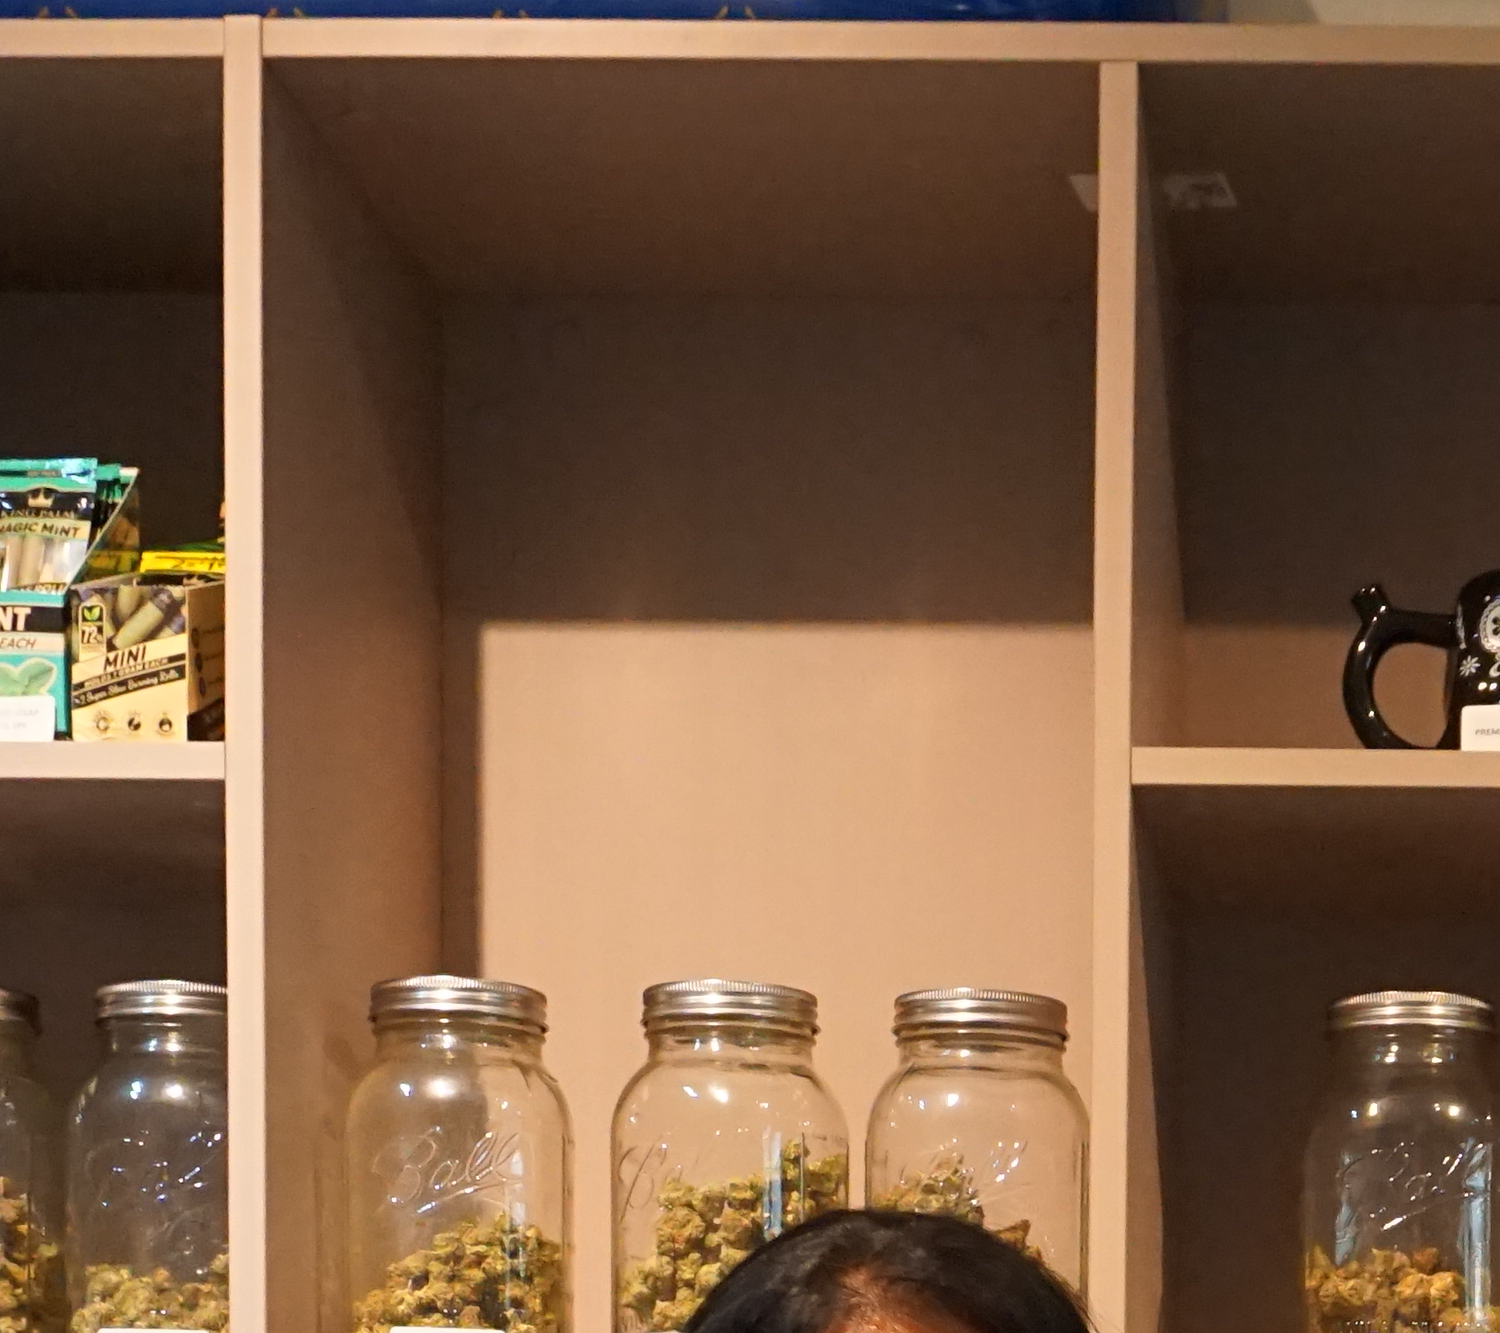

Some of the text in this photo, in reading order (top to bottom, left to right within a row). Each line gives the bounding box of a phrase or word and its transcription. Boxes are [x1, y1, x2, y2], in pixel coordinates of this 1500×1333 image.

[41, 523, 80, 538] MINT
[0, 637, 38, 650] EACH
[103, 644, 147, 673] MINI
